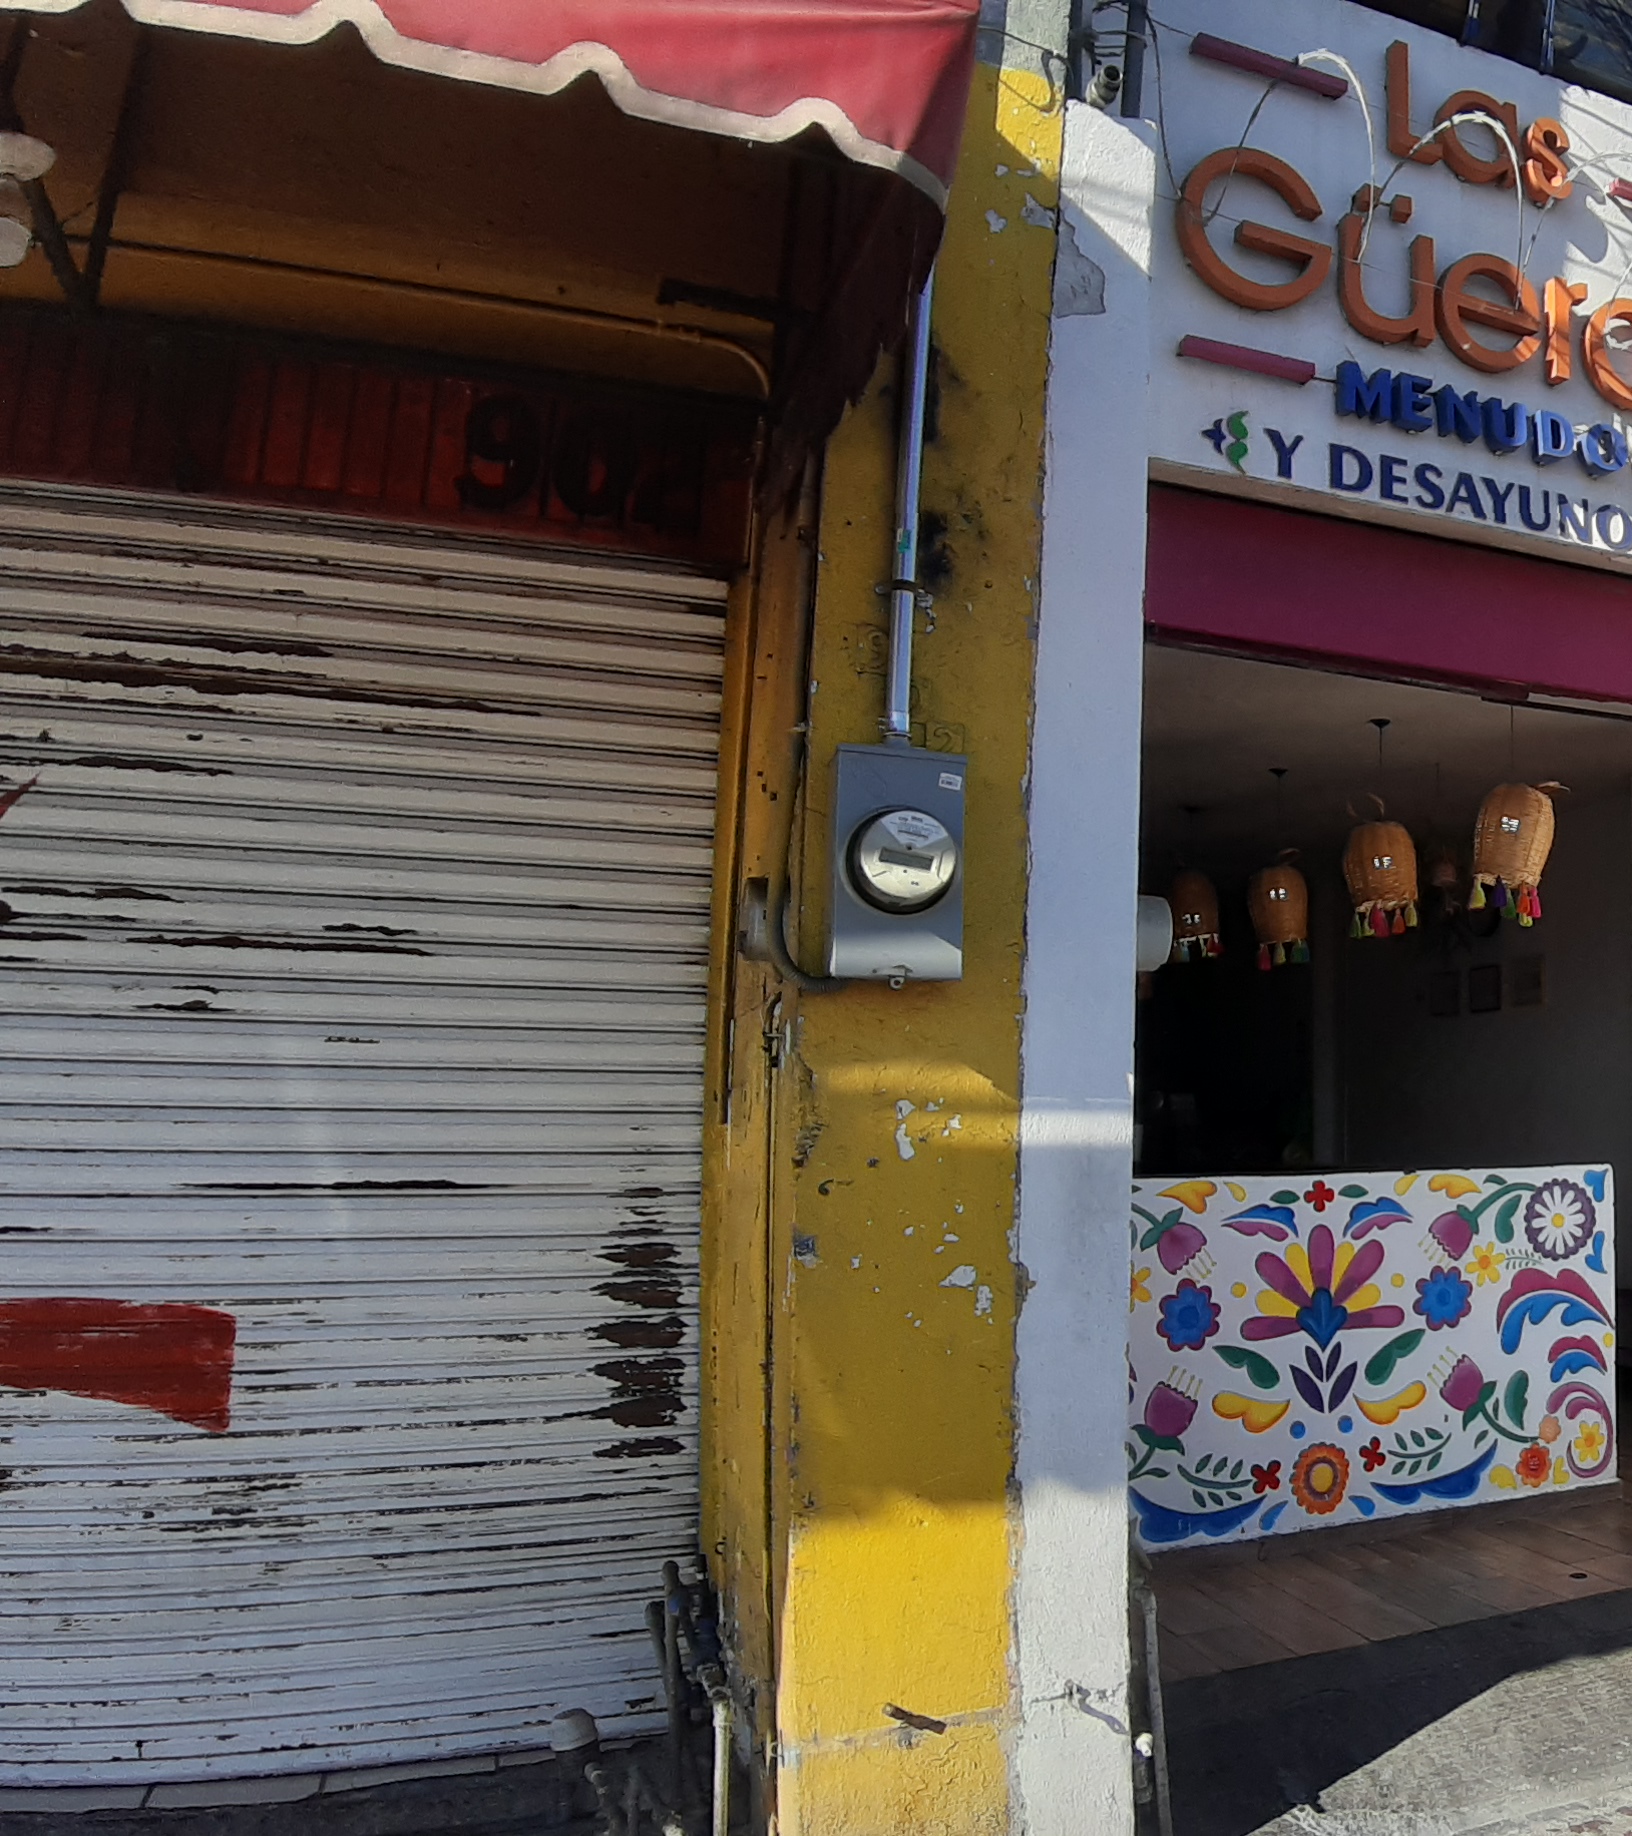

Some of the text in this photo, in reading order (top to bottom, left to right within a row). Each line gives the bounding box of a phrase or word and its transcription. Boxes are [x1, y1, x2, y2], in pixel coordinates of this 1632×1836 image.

[1385, 38, 1572, 206] Las
[1265, 428, 1304, 480] Y
[1335, 359, 1630, 477] MENUDO
